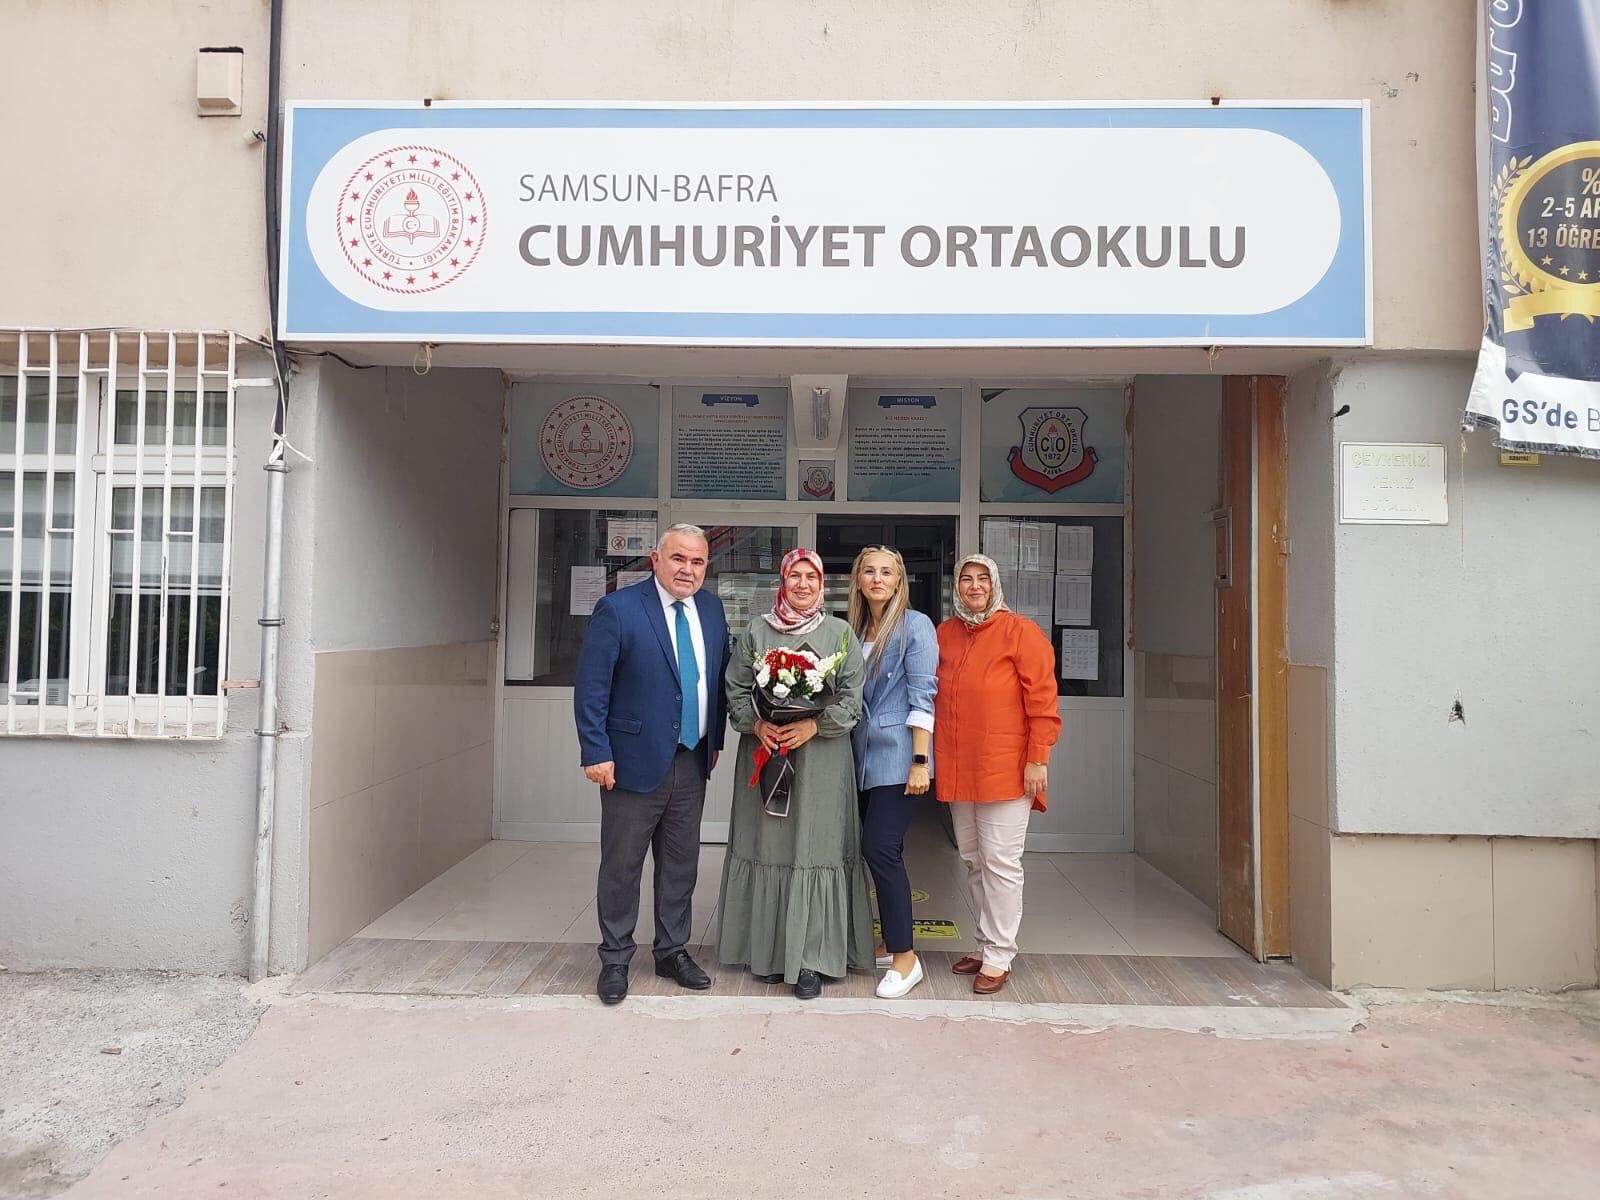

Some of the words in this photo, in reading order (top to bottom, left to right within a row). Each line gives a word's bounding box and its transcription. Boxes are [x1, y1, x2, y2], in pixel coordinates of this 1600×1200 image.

[408, 172, 438, 186] MİLLİ
[520, 175, 777, 202] SAMSUN-BAFRA
[364, 171, 406, 230] CUMHURİYETİ
[437, 183, 459, 215] EĞİTİM
[1541, 197, 1575, 218] 2-5
[366, 231, 401, 265] TÜRKİYE
[423, 218, 459, 264] BAKANLIĞI
[519, 215, 885, 267] CUMHURİYET
[901, 225, 1245, 268] ORTAOKULU
[1527, 227, 1548, 248] 13
[1555, 223, 1600, 249] ÖĞRE
[1502, 399, 1578, 429] GS'de
